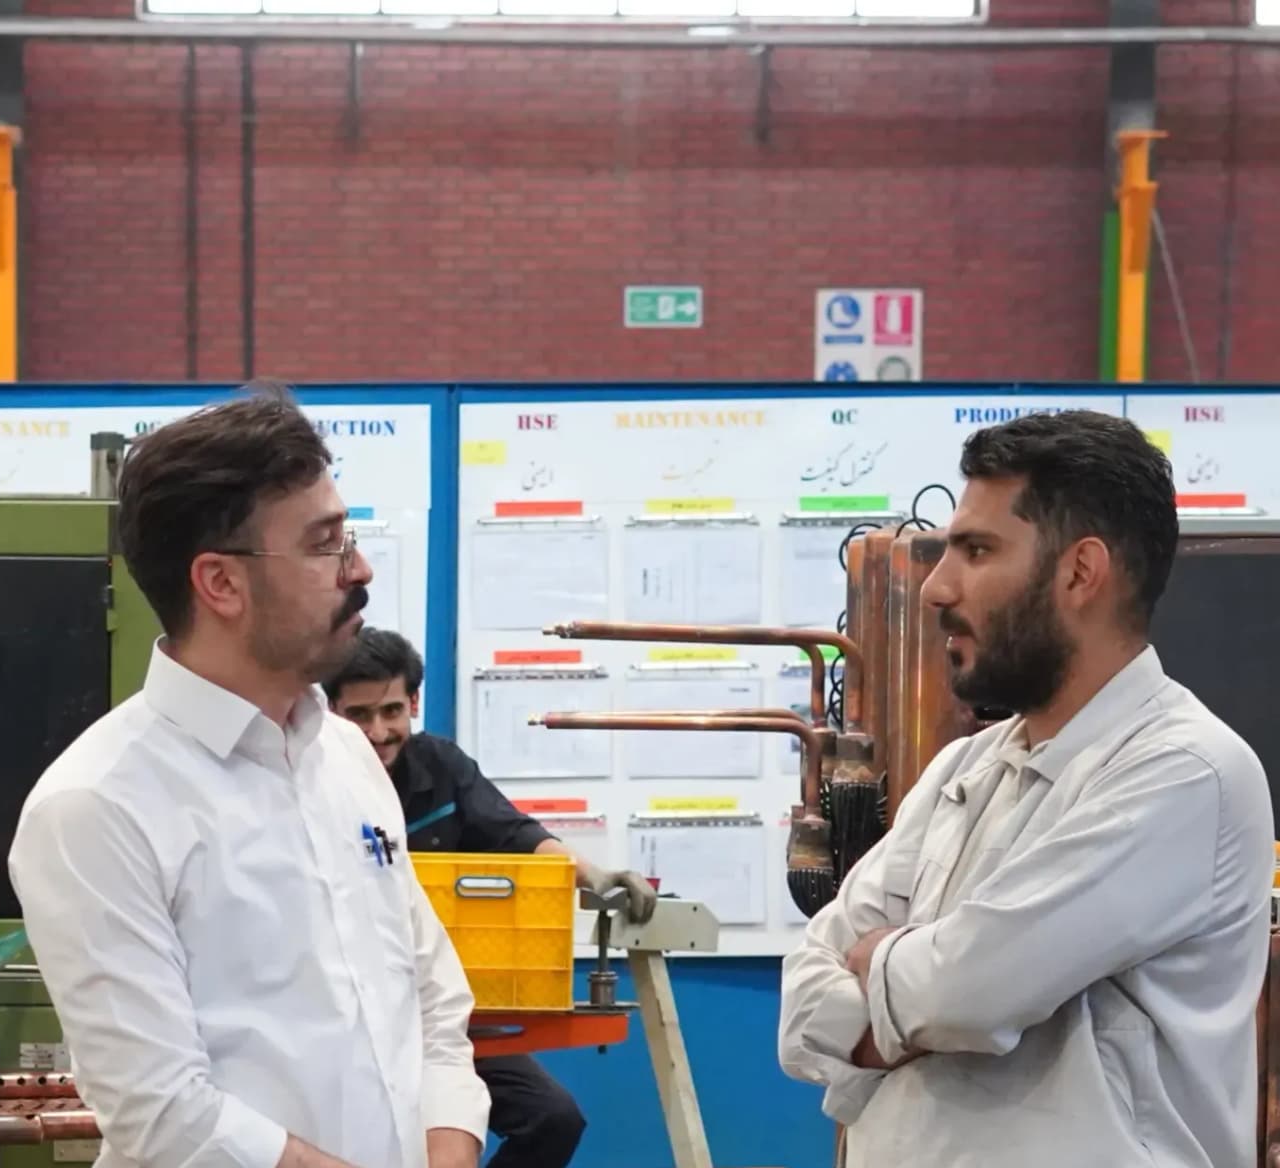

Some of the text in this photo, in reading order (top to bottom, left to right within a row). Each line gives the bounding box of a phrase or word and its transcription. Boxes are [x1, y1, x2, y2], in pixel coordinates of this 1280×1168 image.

[517, 414, 558, 430] HSE
[615, 411, 766, 428] MAINTENANCE
[831, 408, 858, 425] QC
[1184, 406, 1224, 422] HSE
[317, 419, 397, 436] UCTION
